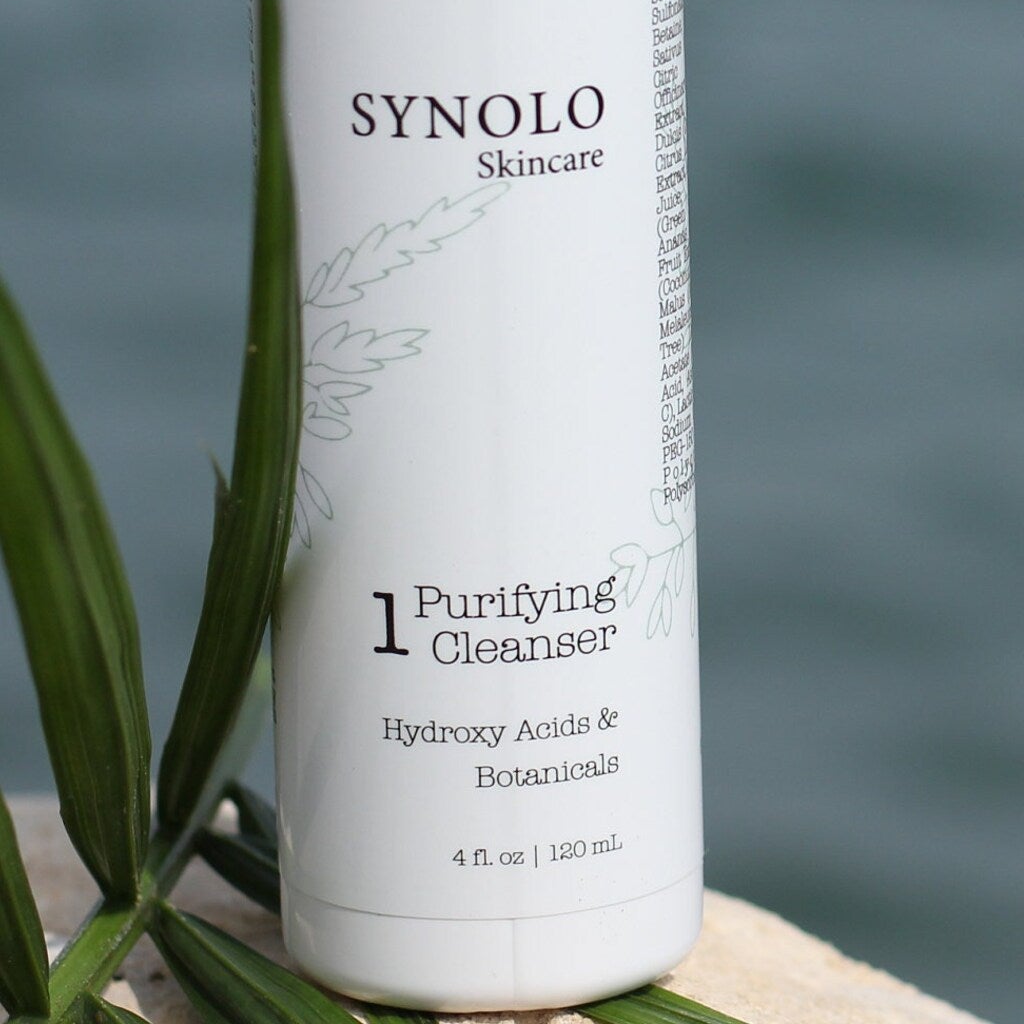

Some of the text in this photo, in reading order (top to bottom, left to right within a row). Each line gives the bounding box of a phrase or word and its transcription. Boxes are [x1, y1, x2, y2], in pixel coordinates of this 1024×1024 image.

[351, 85, 605, 139] SYNOLO
[477, 148, 604, 179] Skincare
[373, 576, 616, 656] 1 Purifying
[432, 624, 617, 664] Cleanser
[382, 707, 619, 748] Hydroxy Acids &
[475, 753, 619, 788] Botanicals
[452, 848, 466, 866] 4
[472, 848, 494, 866] fl.
[499, 852, 525, 866] oz
[549, 840, 587, 862] 120
[591, 834, 623, 855] mL
